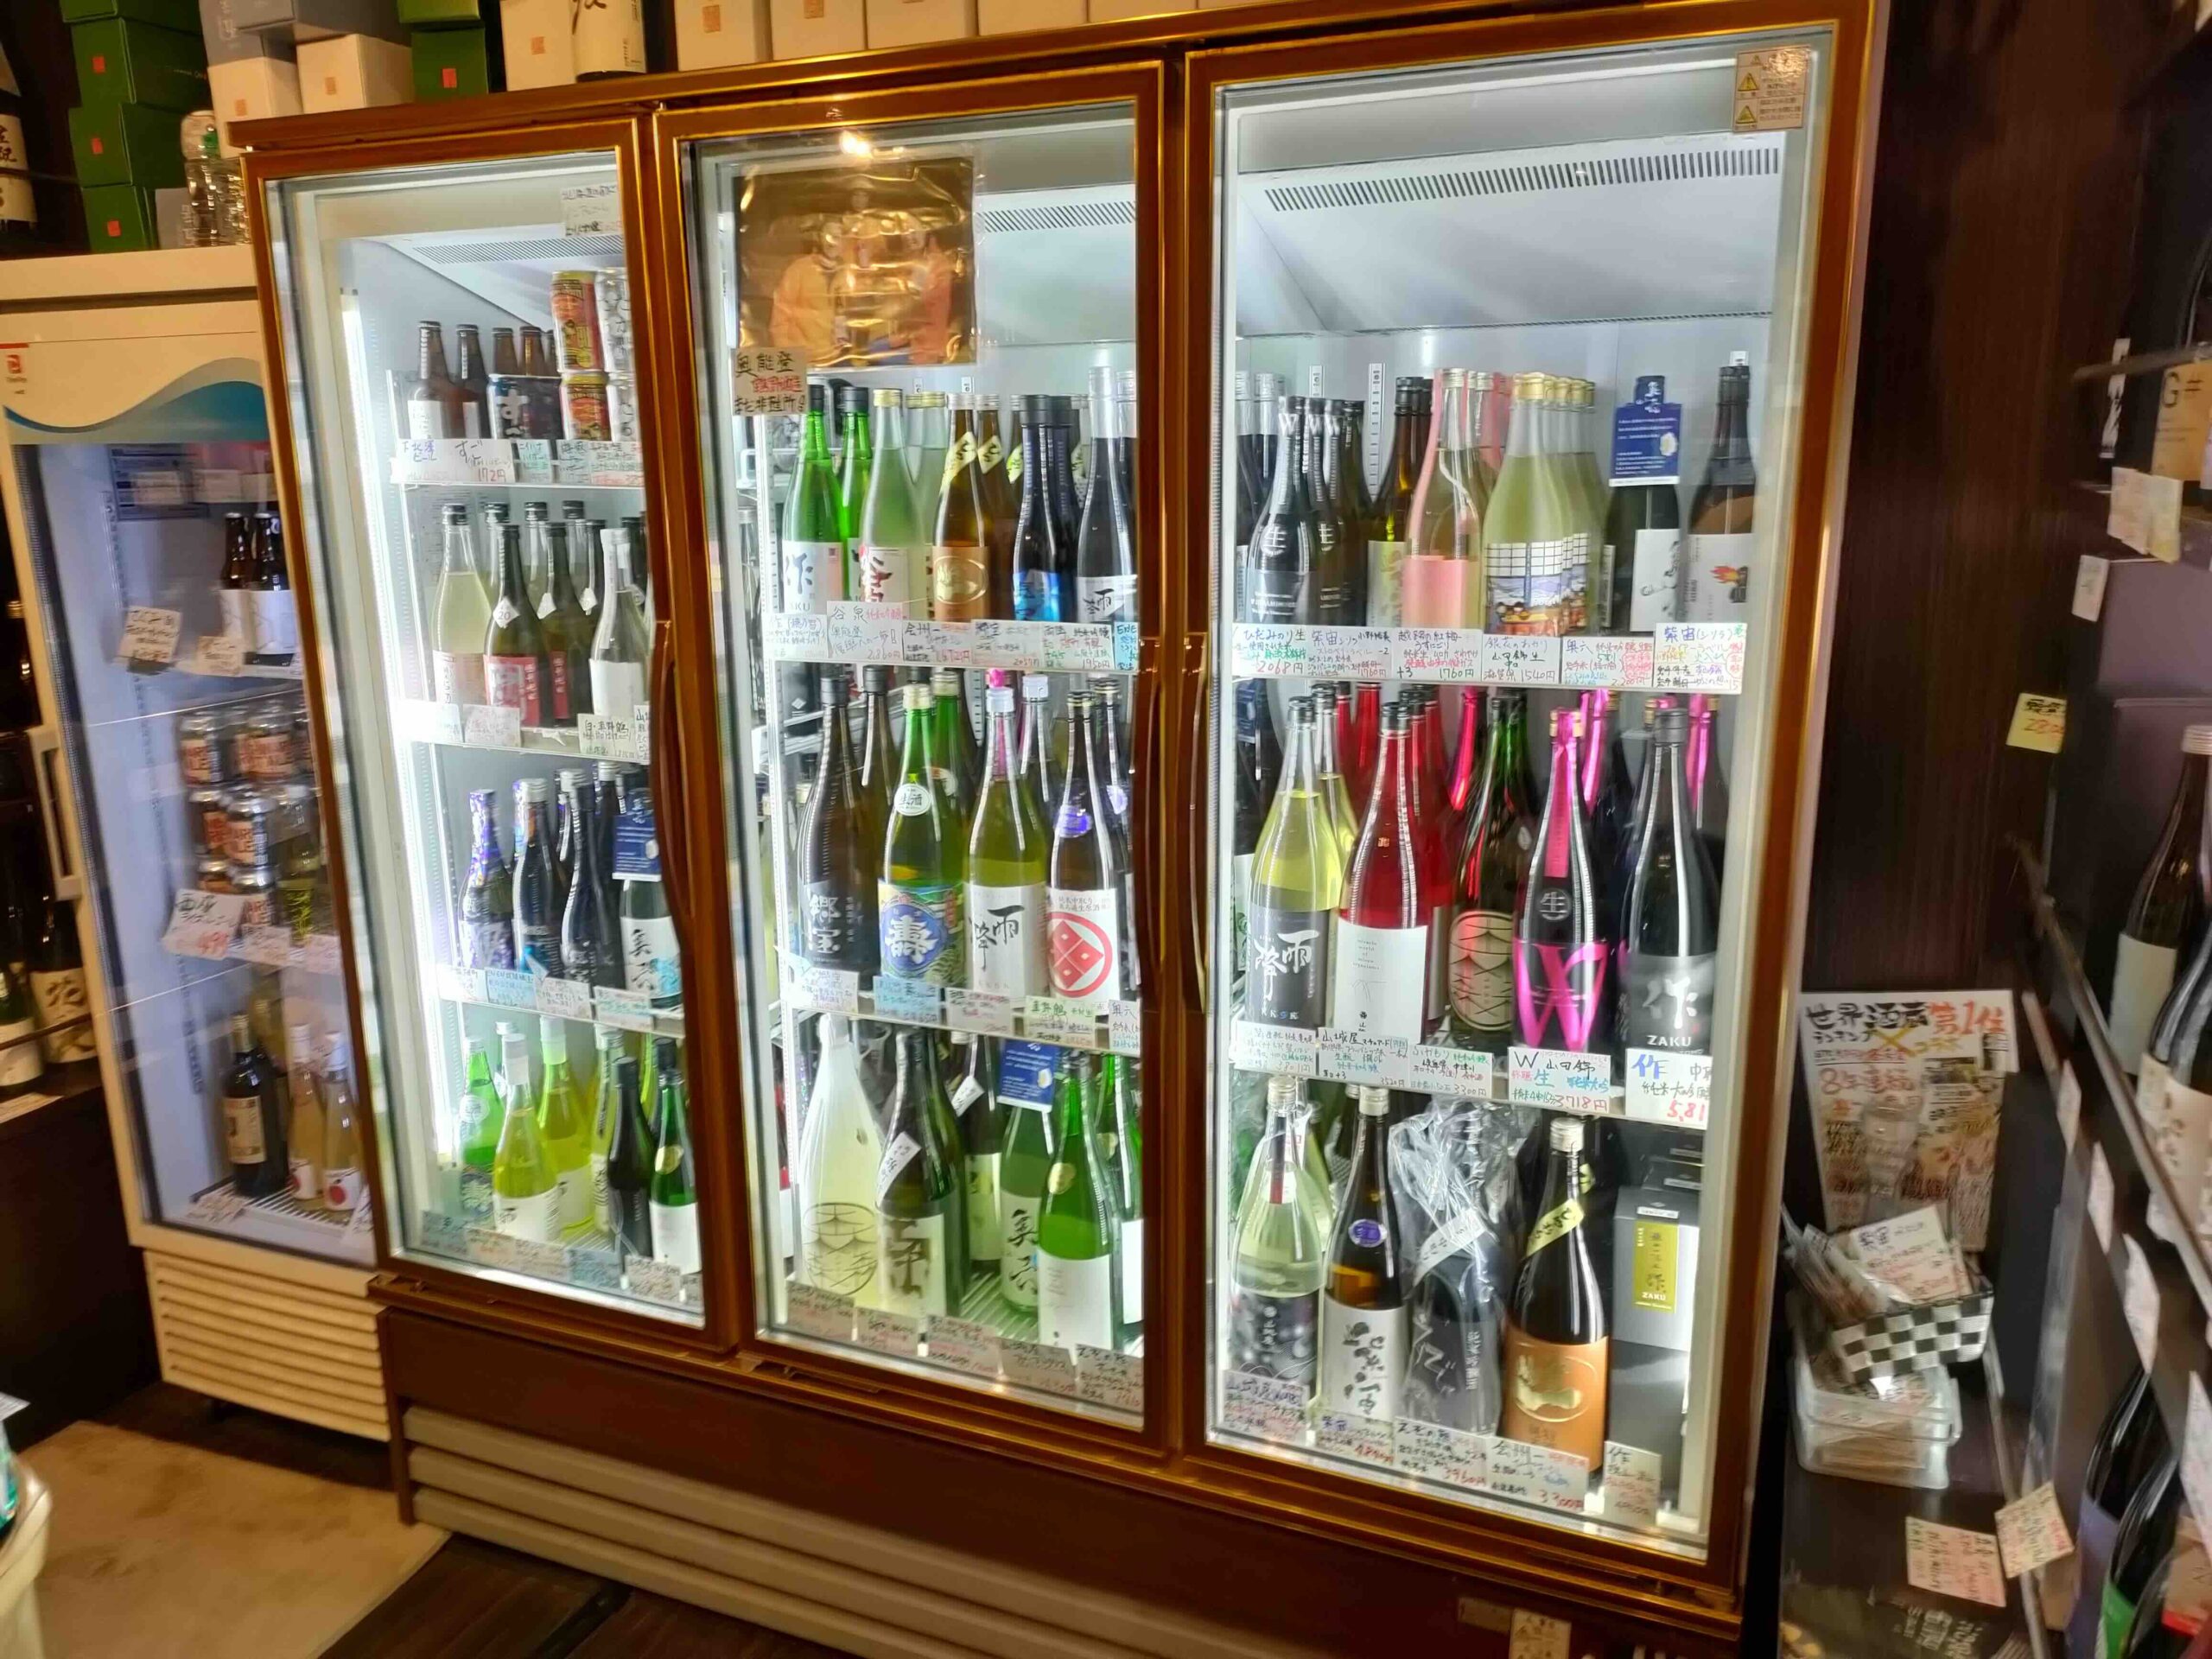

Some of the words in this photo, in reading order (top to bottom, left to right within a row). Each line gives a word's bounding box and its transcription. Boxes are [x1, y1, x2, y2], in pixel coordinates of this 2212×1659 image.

[735, 351, 794, 378] 奥能登
[1257, 659, 1304, 676] 2068円
[1397, 667, 1413, 678] +3
[1439, 667, 1474, 678] 1760円
[1521, 671, 1555, 682] 1540円
[1539, 891, 1570, 913] 生
[1647, 1035, 1692, 1047] ZAKU
[1514, 1051, 1540, 1069] W
[1631, 1052, 1670, 1080] 作
[1535, 1068, 1555, 1087] 生
